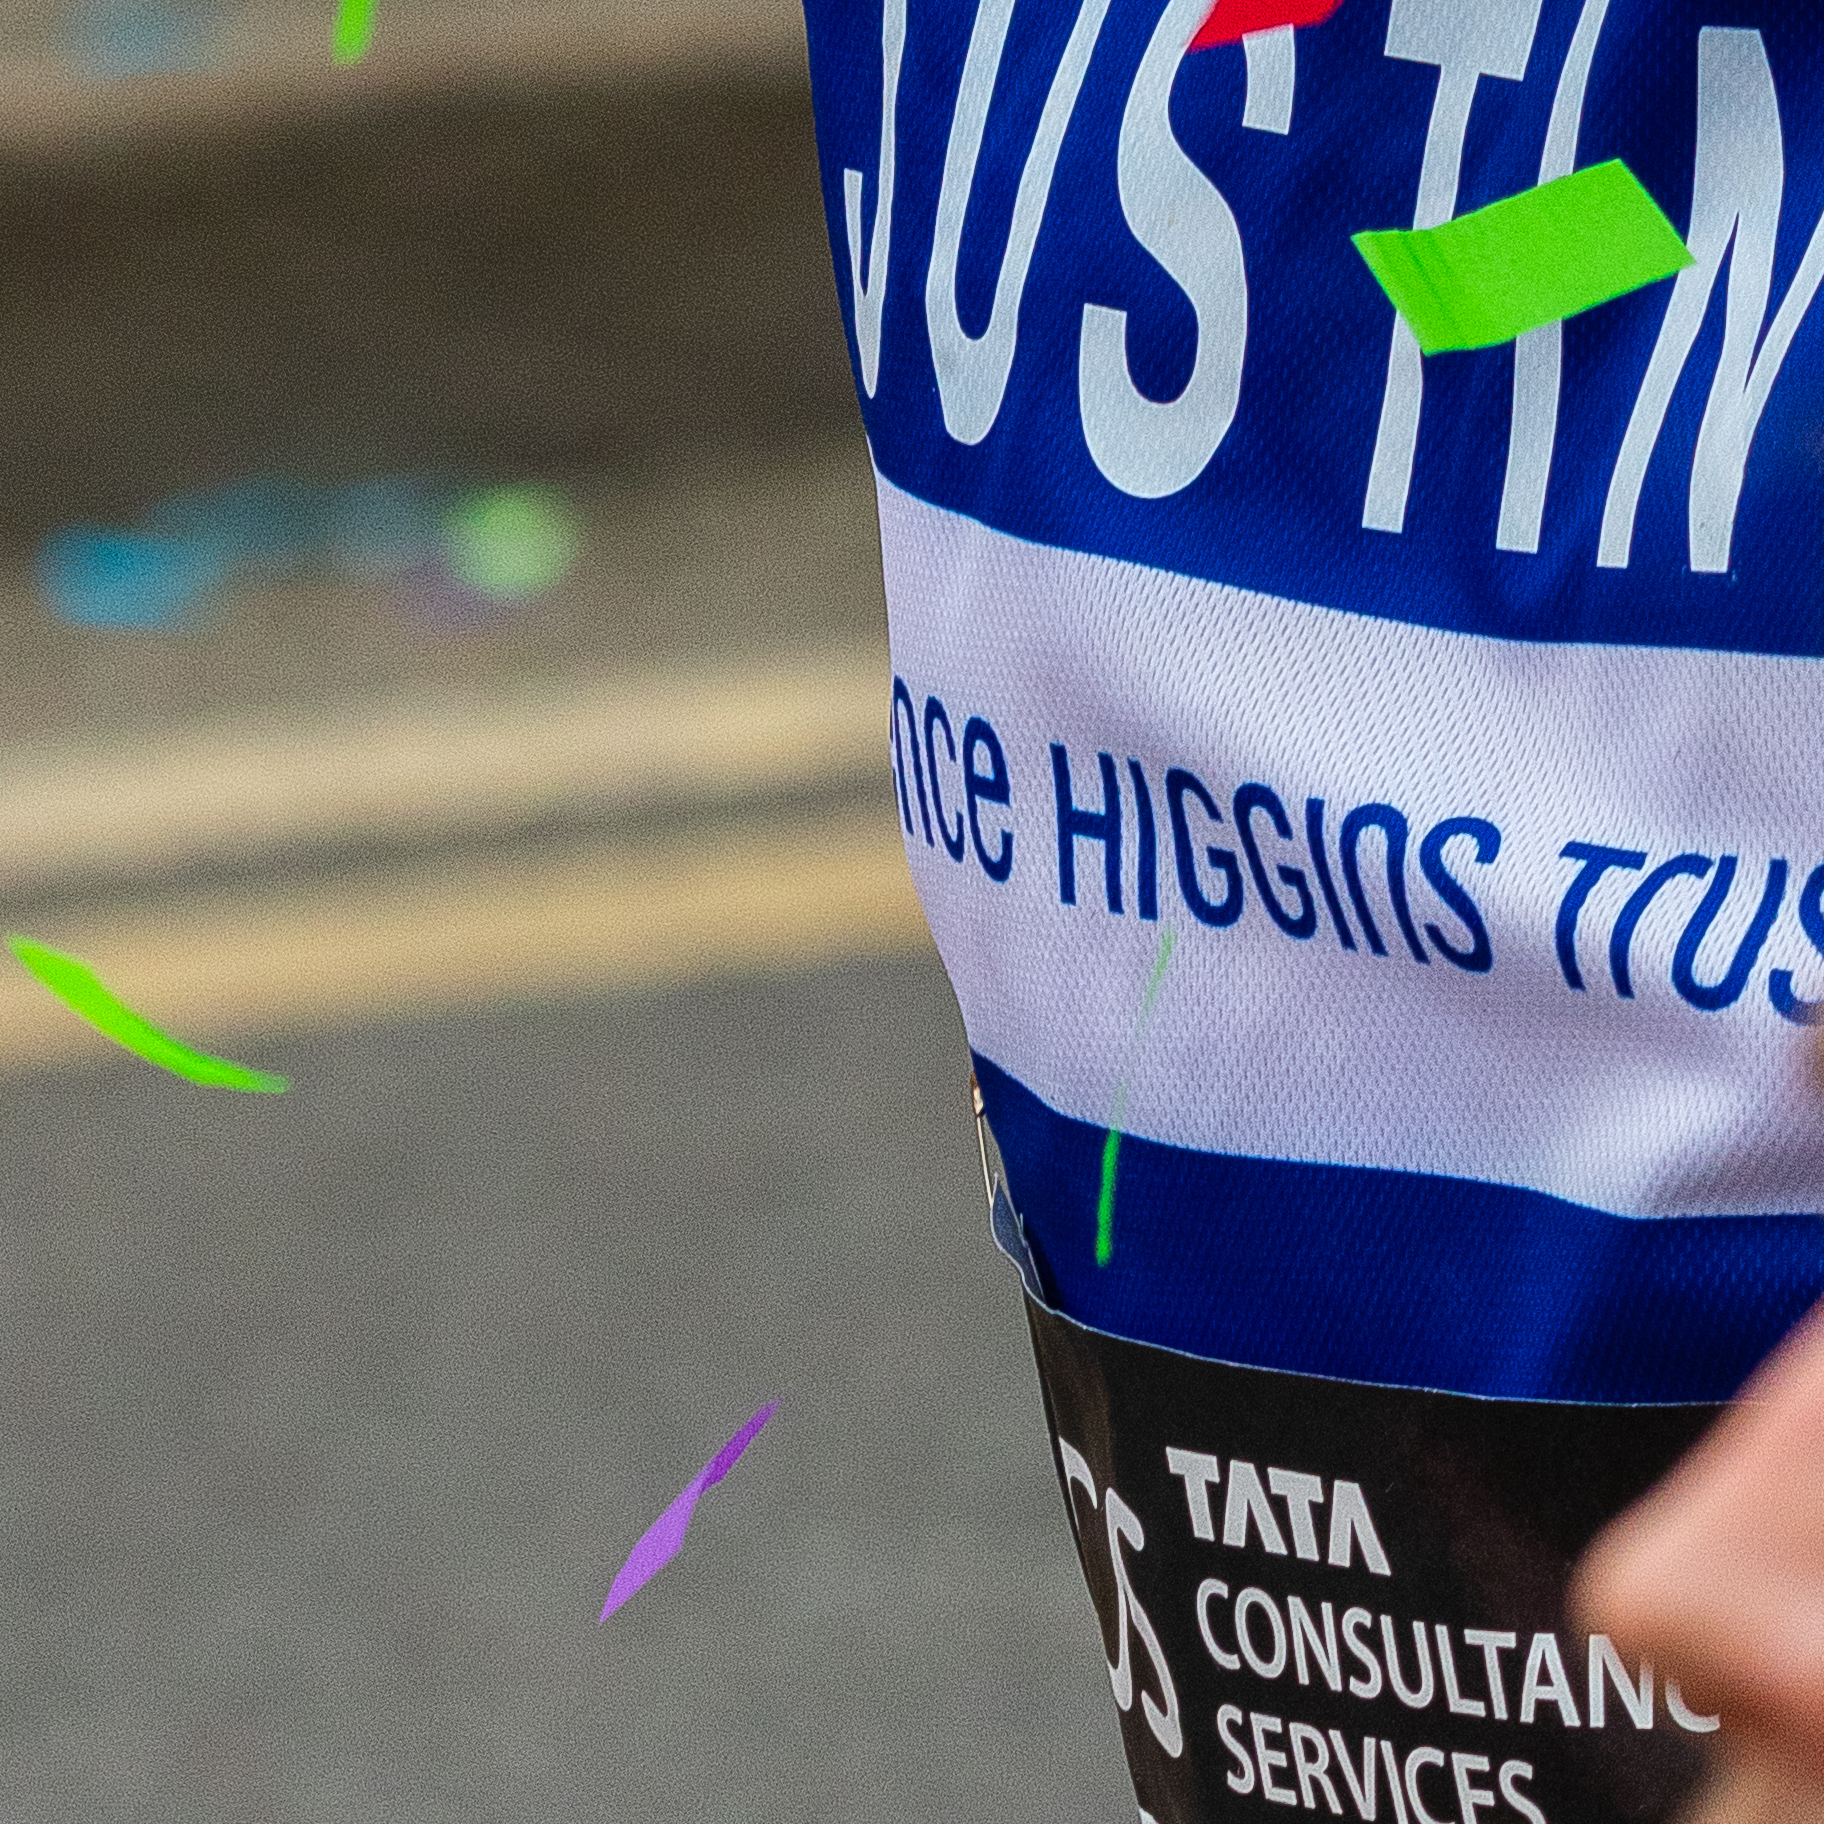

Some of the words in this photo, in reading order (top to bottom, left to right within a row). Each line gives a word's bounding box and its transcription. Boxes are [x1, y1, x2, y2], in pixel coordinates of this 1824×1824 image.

[890, 674, 1013, 884] nce
[1165, 1446, 1392, 1576] TATA
[1217, 1704, 1548, 1824] SERVICES
